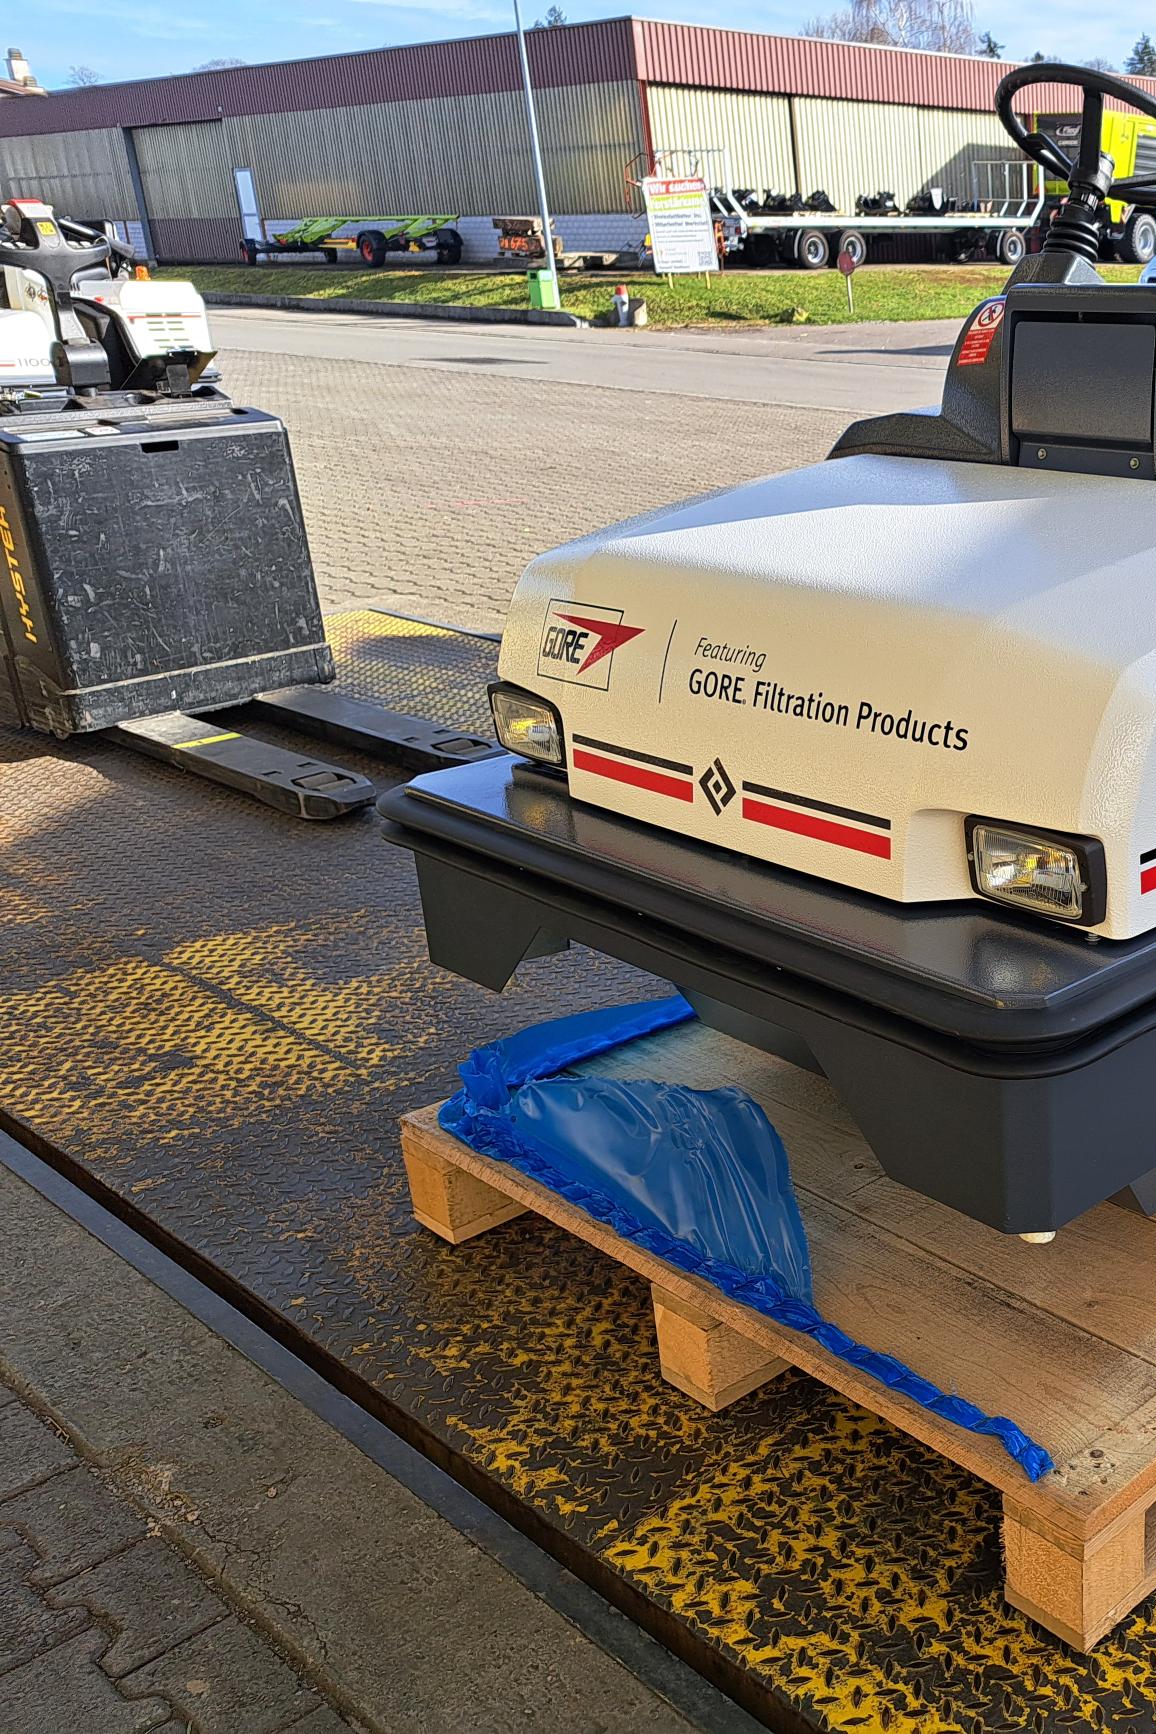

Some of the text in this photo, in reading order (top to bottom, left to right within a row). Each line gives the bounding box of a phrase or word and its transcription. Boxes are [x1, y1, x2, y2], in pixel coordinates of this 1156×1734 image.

[542, 625, 589, 664] GORE
[694, 637, 767, 672] Featuring
[753, 681, 849, 726] Filtration
[856, 702, 970, 751] Products
